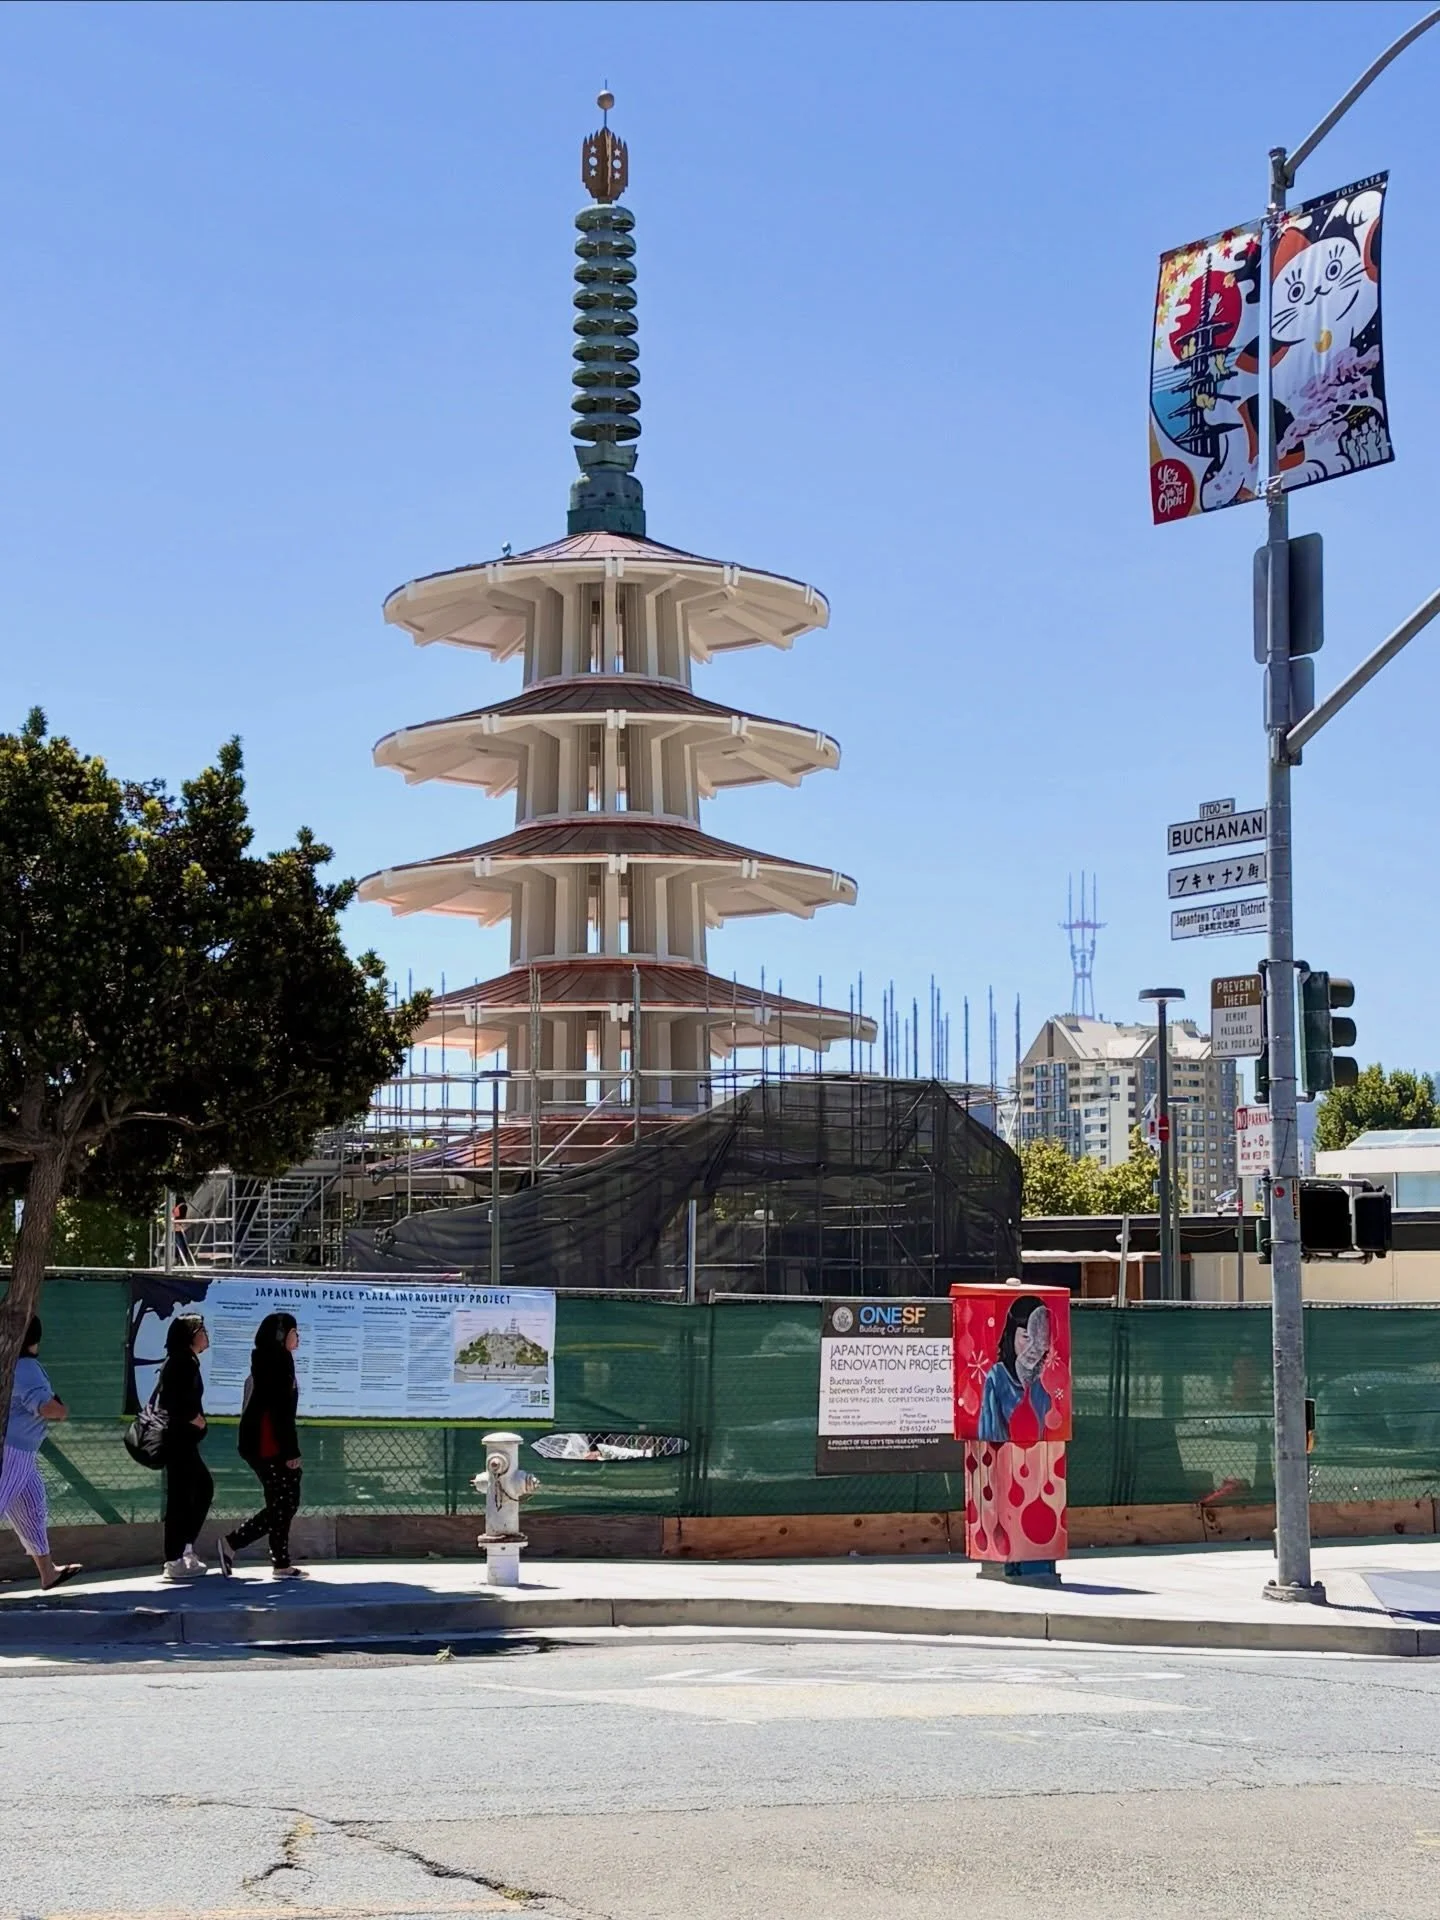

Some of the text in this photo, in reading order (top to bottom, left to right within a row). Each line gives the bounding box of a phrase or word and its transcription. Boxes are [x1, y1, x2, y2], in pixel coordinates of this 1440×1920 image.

[1358, 175, 1381, 190] CATS
[1202, 803, 1221, 816] 1700
[1172, 816, 1263, 847] BUCHANAN
[1175, 901, 1266, 928] Japantown Cultural District
[1217, 979, 1256, 994] PREVENT
[1223, 993, 1249, 1006] THEFT
[1226, 1011, 1248, 1022] REMOVE
[1221, 1025, 1253, 1036] VALUABLES
[1231, 1039, 1246, 1049] YOUR
[1237, 1110, 1269, 1129] NO PARKIN
[255, 1287, 512, 1304] JAPANTOWN PEACE PLAZA IMPROVEMENT PROJECT
[860, 1306, 926, 1324] ONESF
[859, 1325, 924, 1335] Building Our Future
[830, 1344, 903, 1359] JAPANTOWN
[906, 1344, 939, 1356] PEACE
[830, 1359, 953, 1373] RENOVATION PROJECT
[829, 1376, 884, 1385] Buchanan Street
[829, 1386, 859, 1394] between
[861, 1385, 876, 1394] Post
[878, 1385, 898, 1394] Street
[900, 1385, 912, 1393] and
[914, 1385, 934, 1395] Geary
